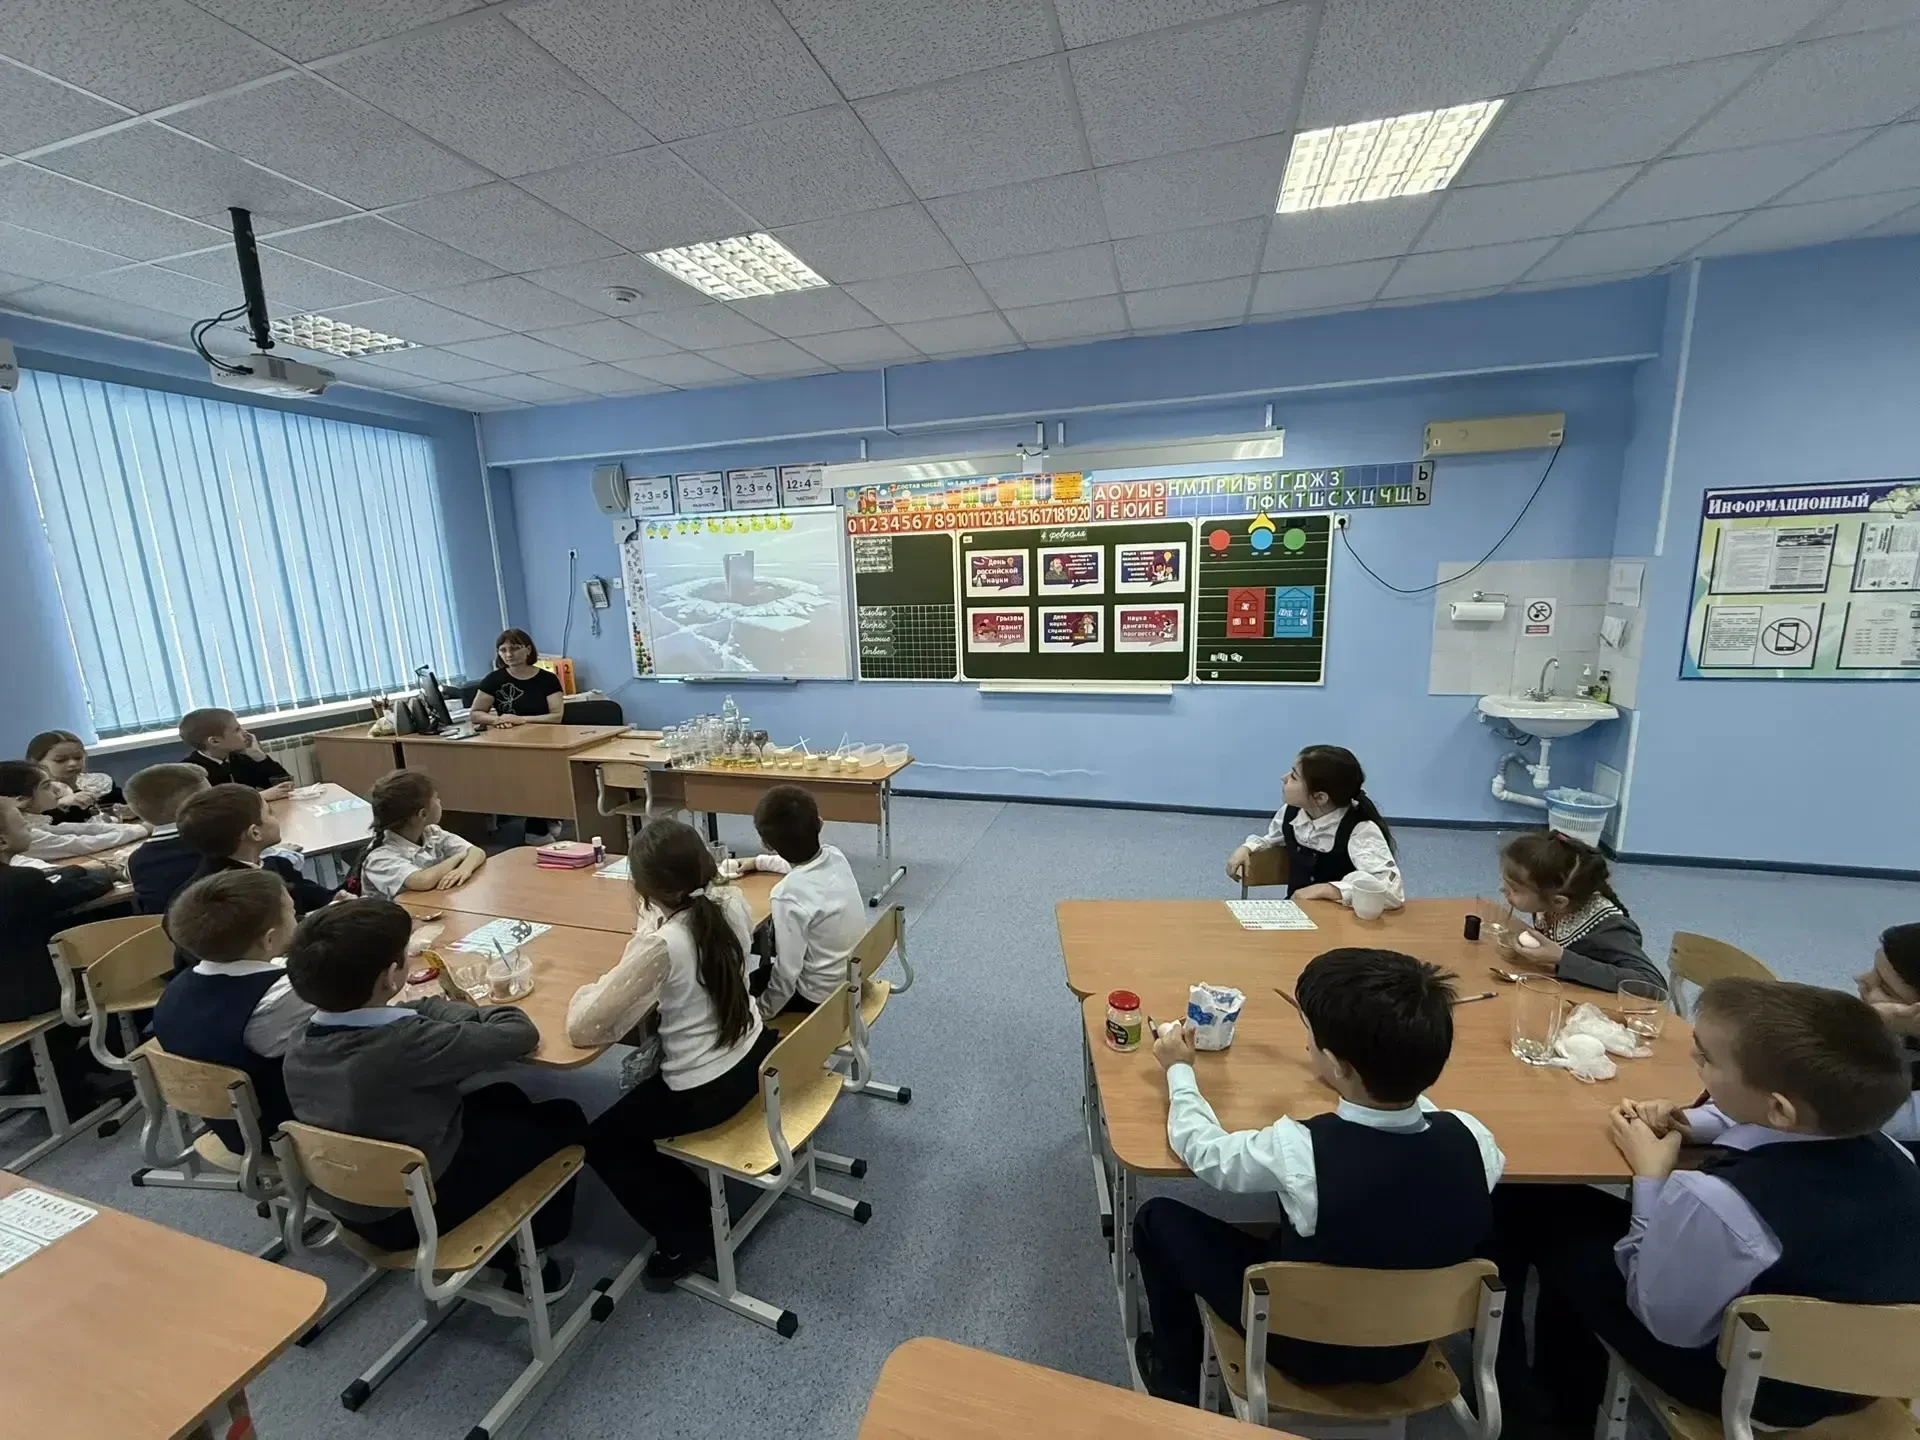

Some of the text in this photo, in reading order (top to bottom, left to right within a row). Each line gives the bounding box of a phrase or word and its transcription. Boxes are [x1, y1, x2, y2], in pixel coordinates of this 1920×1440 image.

[848, 506, 1090, 532] 0 1 2 3 4 5 6 7 8 9 10 11 12 13 14 15 16 17 18 19 20
